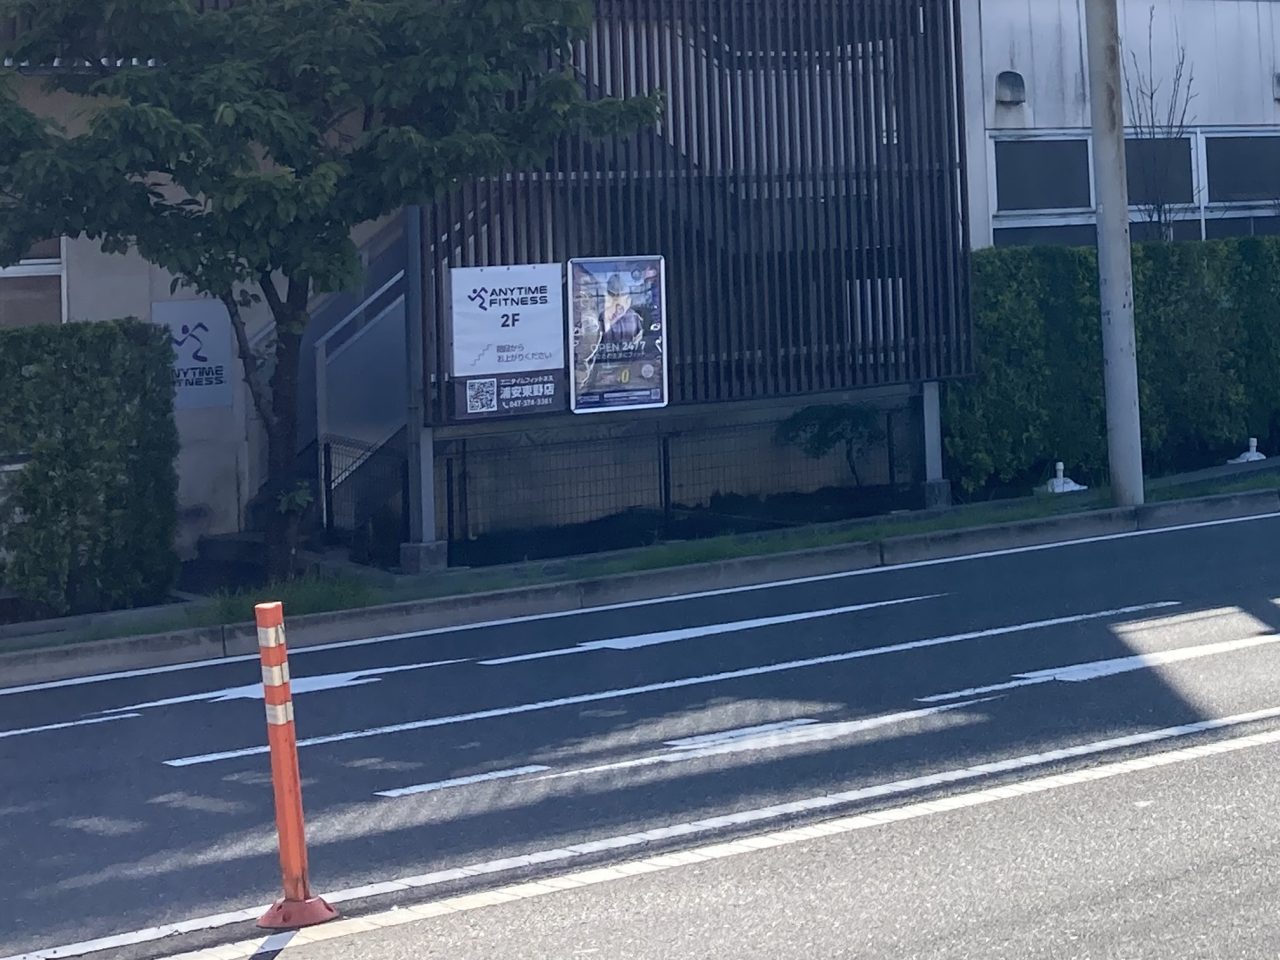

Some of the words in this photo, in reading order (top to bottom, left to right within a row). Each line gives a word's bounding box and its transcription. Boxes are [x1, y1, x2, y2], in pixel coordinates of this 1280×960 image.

[489, 285, 548, 297] ANYTIME
[489, 295, 548, 307] FITNESS
[500, 313, 520, 328] 2F
[500, 383, 555, 399] 浦安東野店
